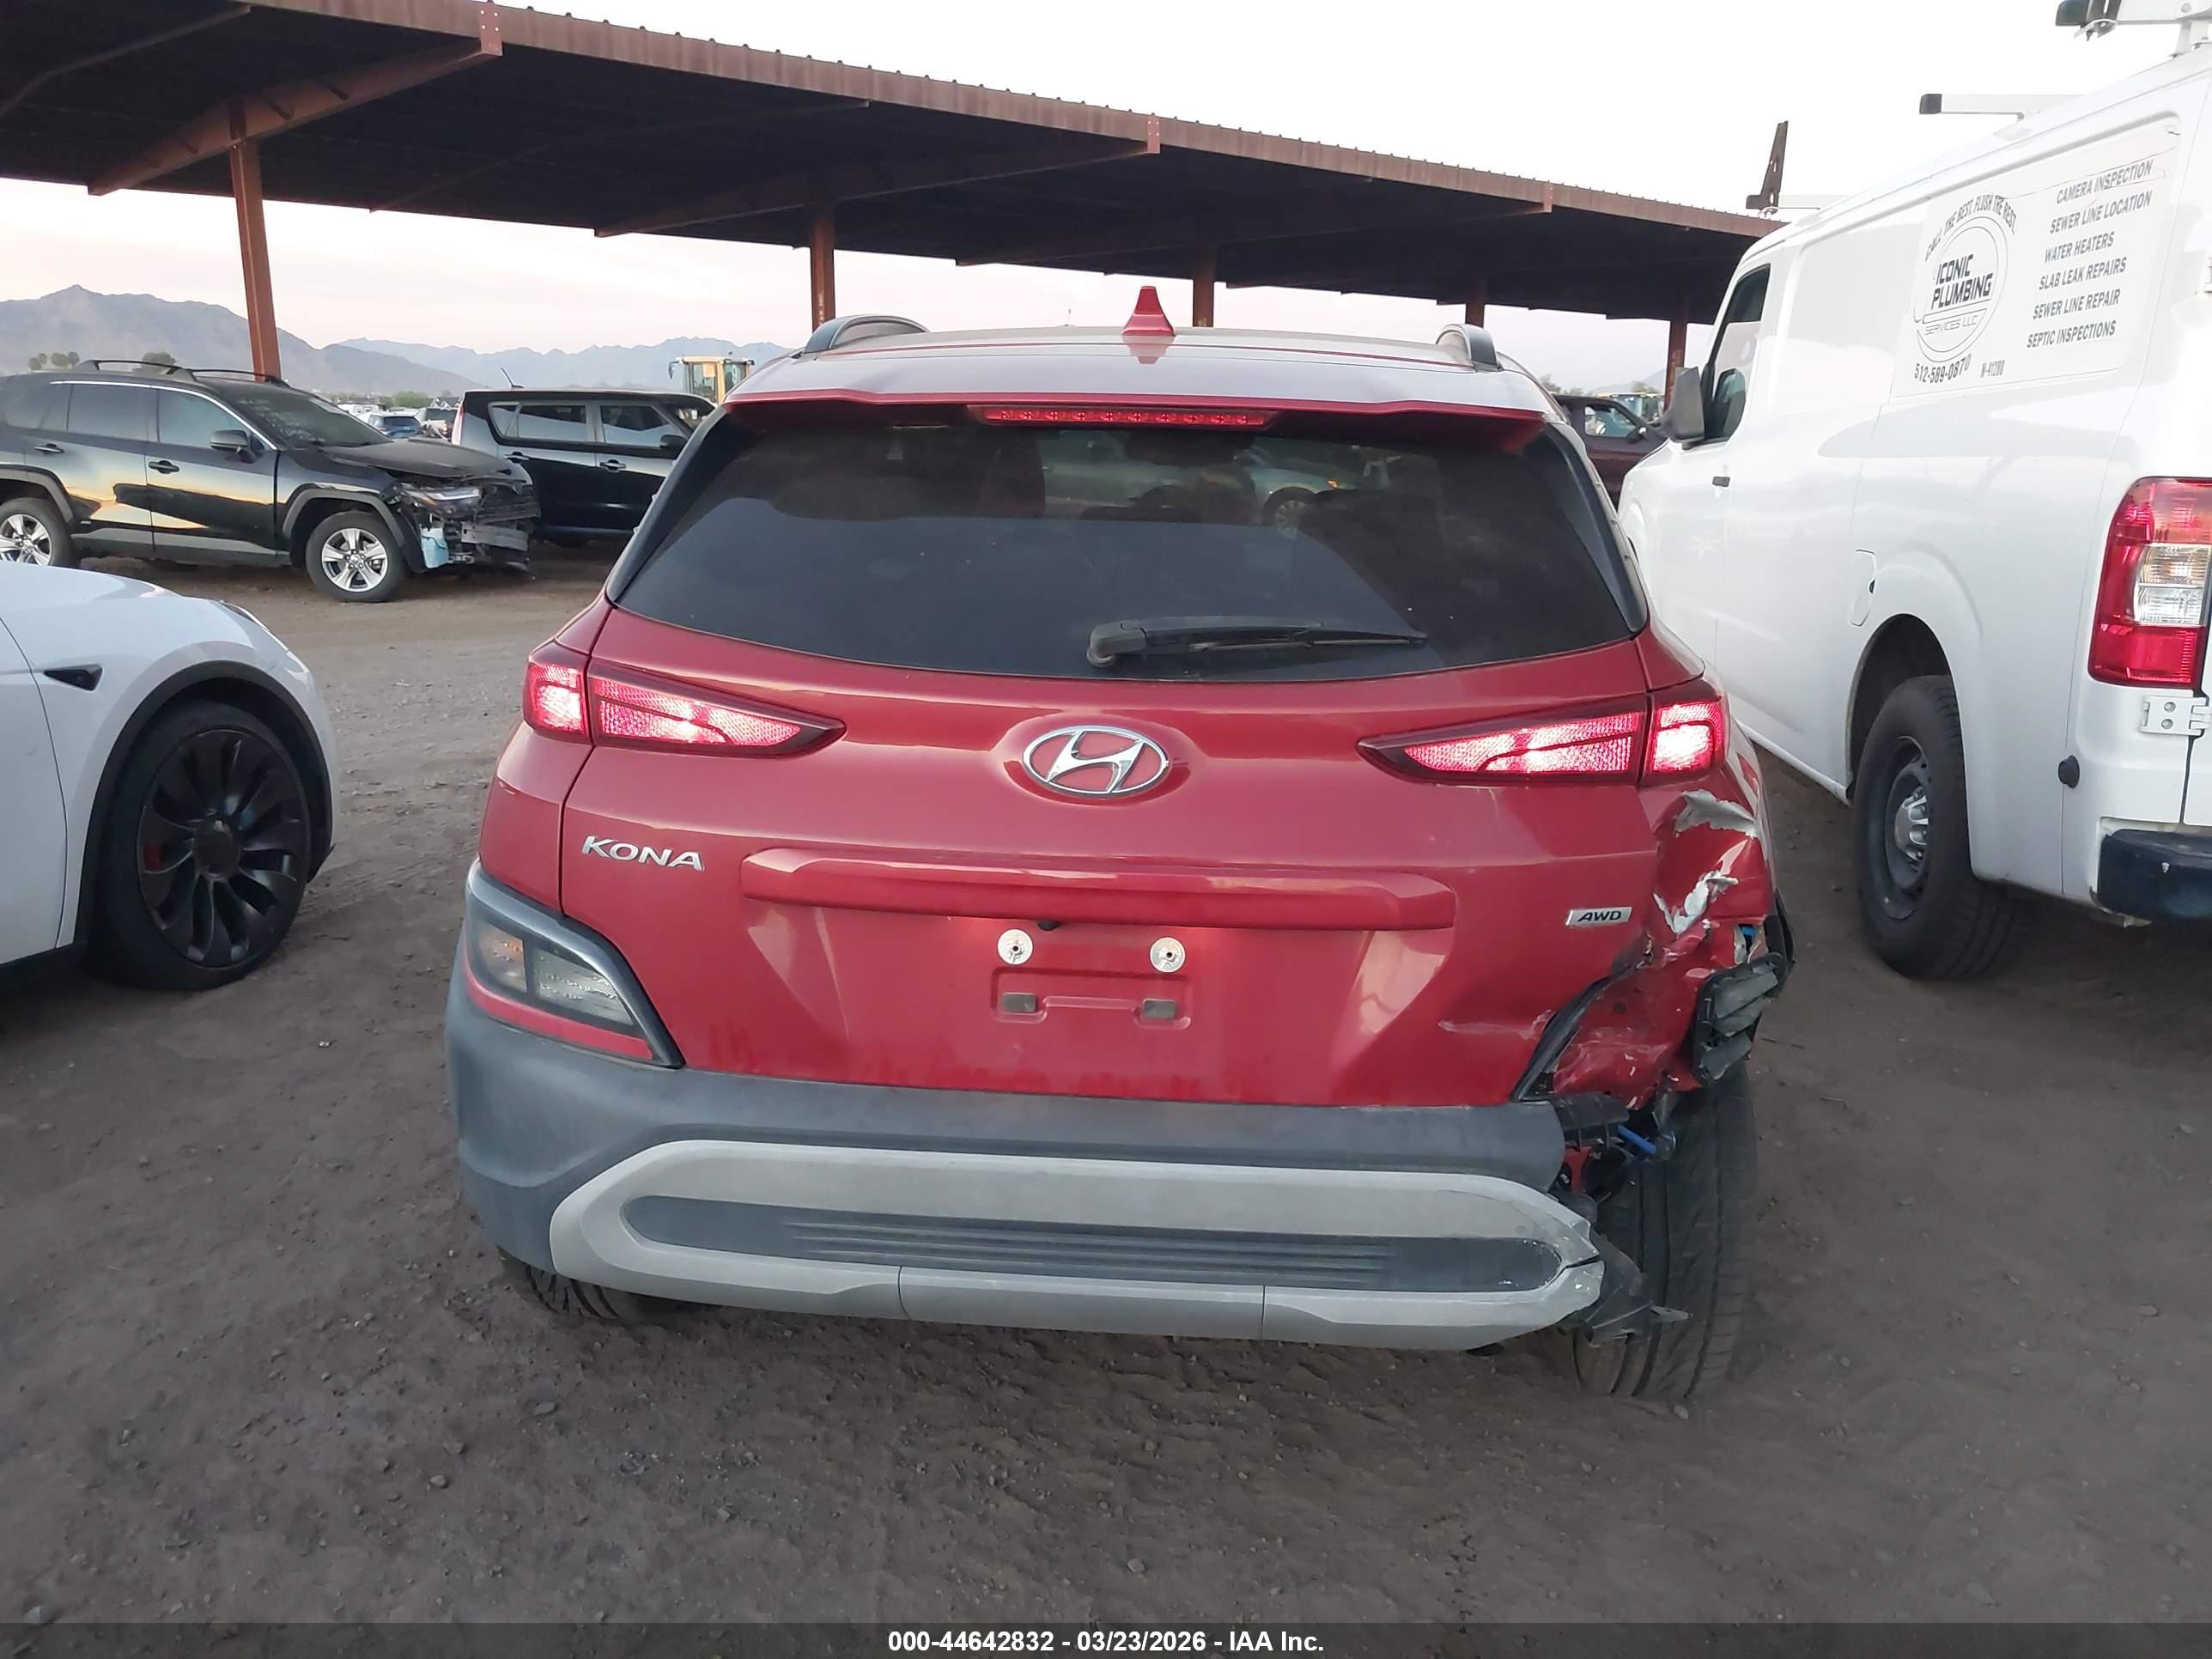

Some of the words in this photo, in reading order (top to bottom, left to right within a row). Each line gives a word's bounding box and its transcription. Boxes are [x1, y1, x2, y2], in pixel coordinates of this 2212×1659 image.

[2057, 179, 2093, 204] CAMERA
[2094, 159, 2154, 189] INSPECTION
[2050, 211, 2081, 234] SEWER
[2081, 204, 2103, 225] LINE
[2104, 190, 2153, 218] LOCATION
[2045, 242, 2073, 263] WATER
[2074, 231, 2115, 256] HEATERS
[1936, 254, 1973, 285] ICONIC
[2039, 272, 2061, 290] SLAB
[2062, 266, 2085, 286] LEAK
[2086, 257, 2127, 280] REPAIRS
[1931, 272, 1993, 309] PLUMBING
[2033, 301, 2063, 319] SEWER
[2063, 295, 2085, 314] LINE
[2085, 289, 2121, 310] REPAIR
[2027, 330, 2056, 349] SEPTIC
[2057, 320, 2116, 343] INSPECTIONS
[1914, 354, 1972, 383] 512-589-0870
[581, 836, 705, 872] KONA
[1577, 910, 1622, 922] AWD
